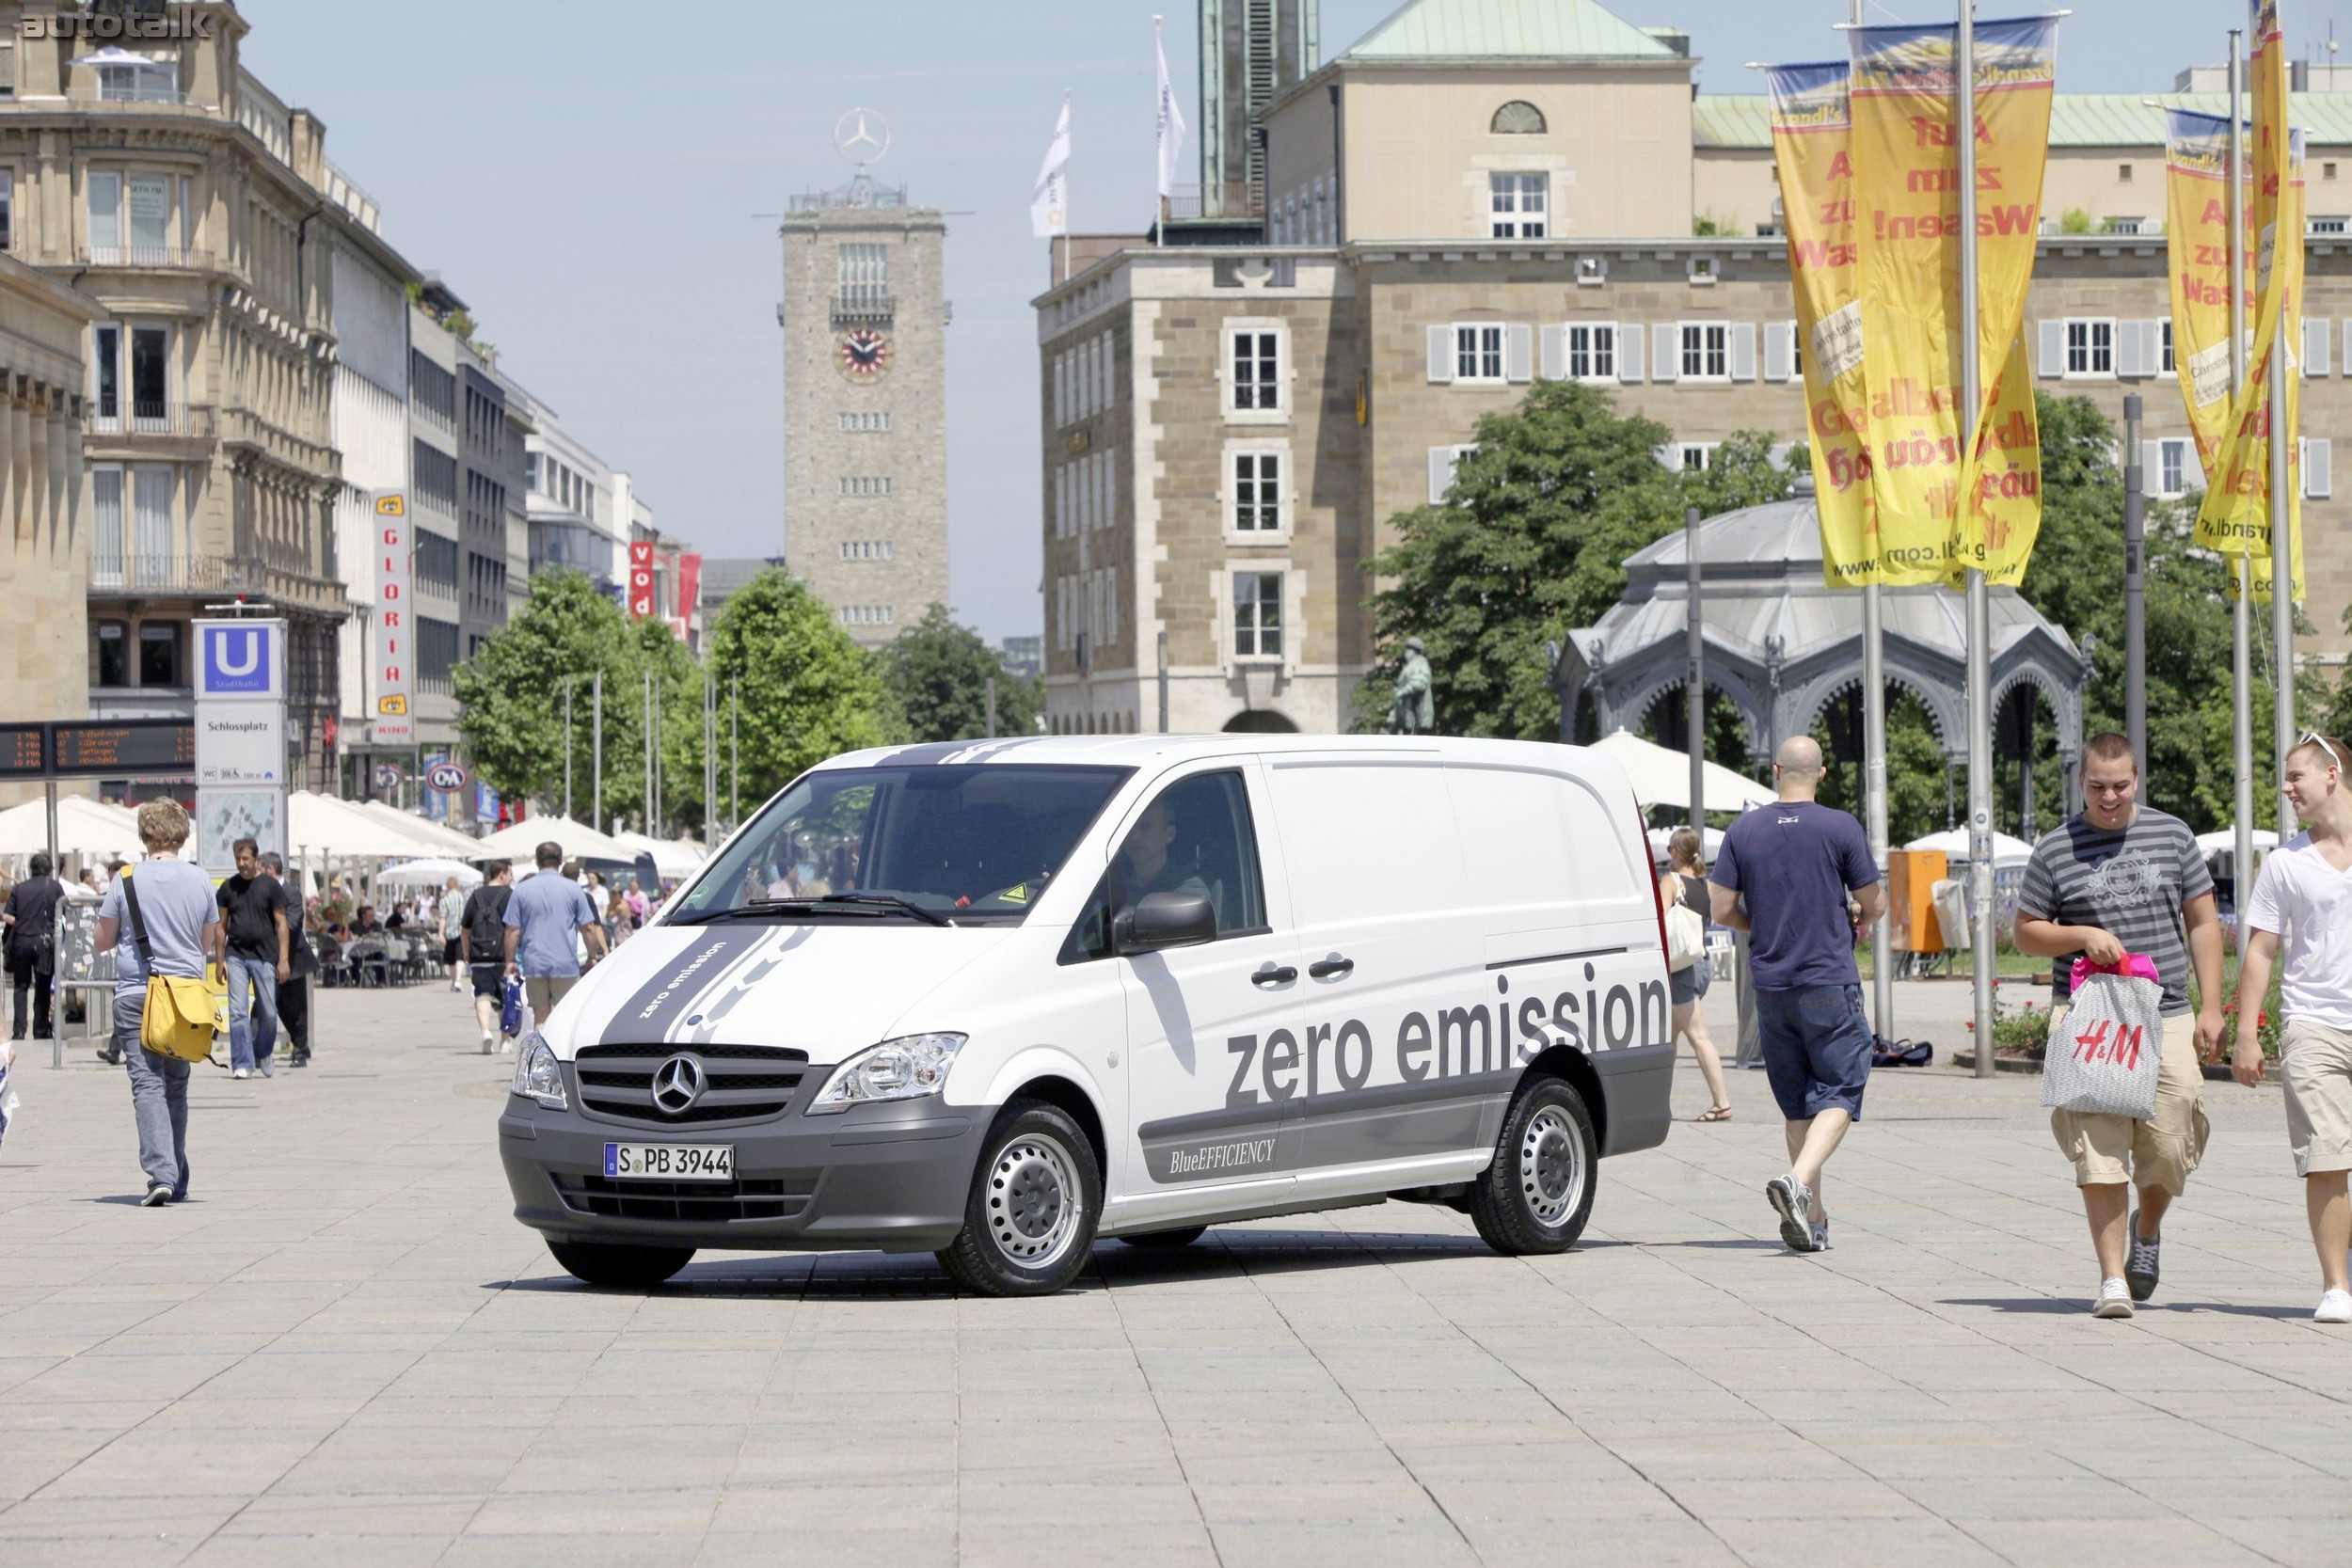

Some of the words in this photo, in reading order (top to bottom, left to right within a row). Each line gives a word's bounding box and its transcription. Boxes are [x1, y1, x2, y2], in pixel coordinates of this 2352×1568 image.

[384, 529, 399, 681] GLORIA
[215, 631, 259, 676] U
[208, 721, 268, 733] Schlossplatz
[379, 726, 408, 735] KINO
[203, 769, 216, 778] WC
[639, 991, 670, 1019] zero
[667, 942, 727, 990] emission
[1226, 1019, 1373, 1109] zero
[1396, 961, 1667, 1084] emission
[2073, 1019, 2142, 1071] H&M
[619, 1148, 630, 1172] S
[644, 1148, 670, 1173] PB
[675, 1149, 728, 1174] 3944
[1169, 1139, 1276, 1174] BlueEFFICIENCY
